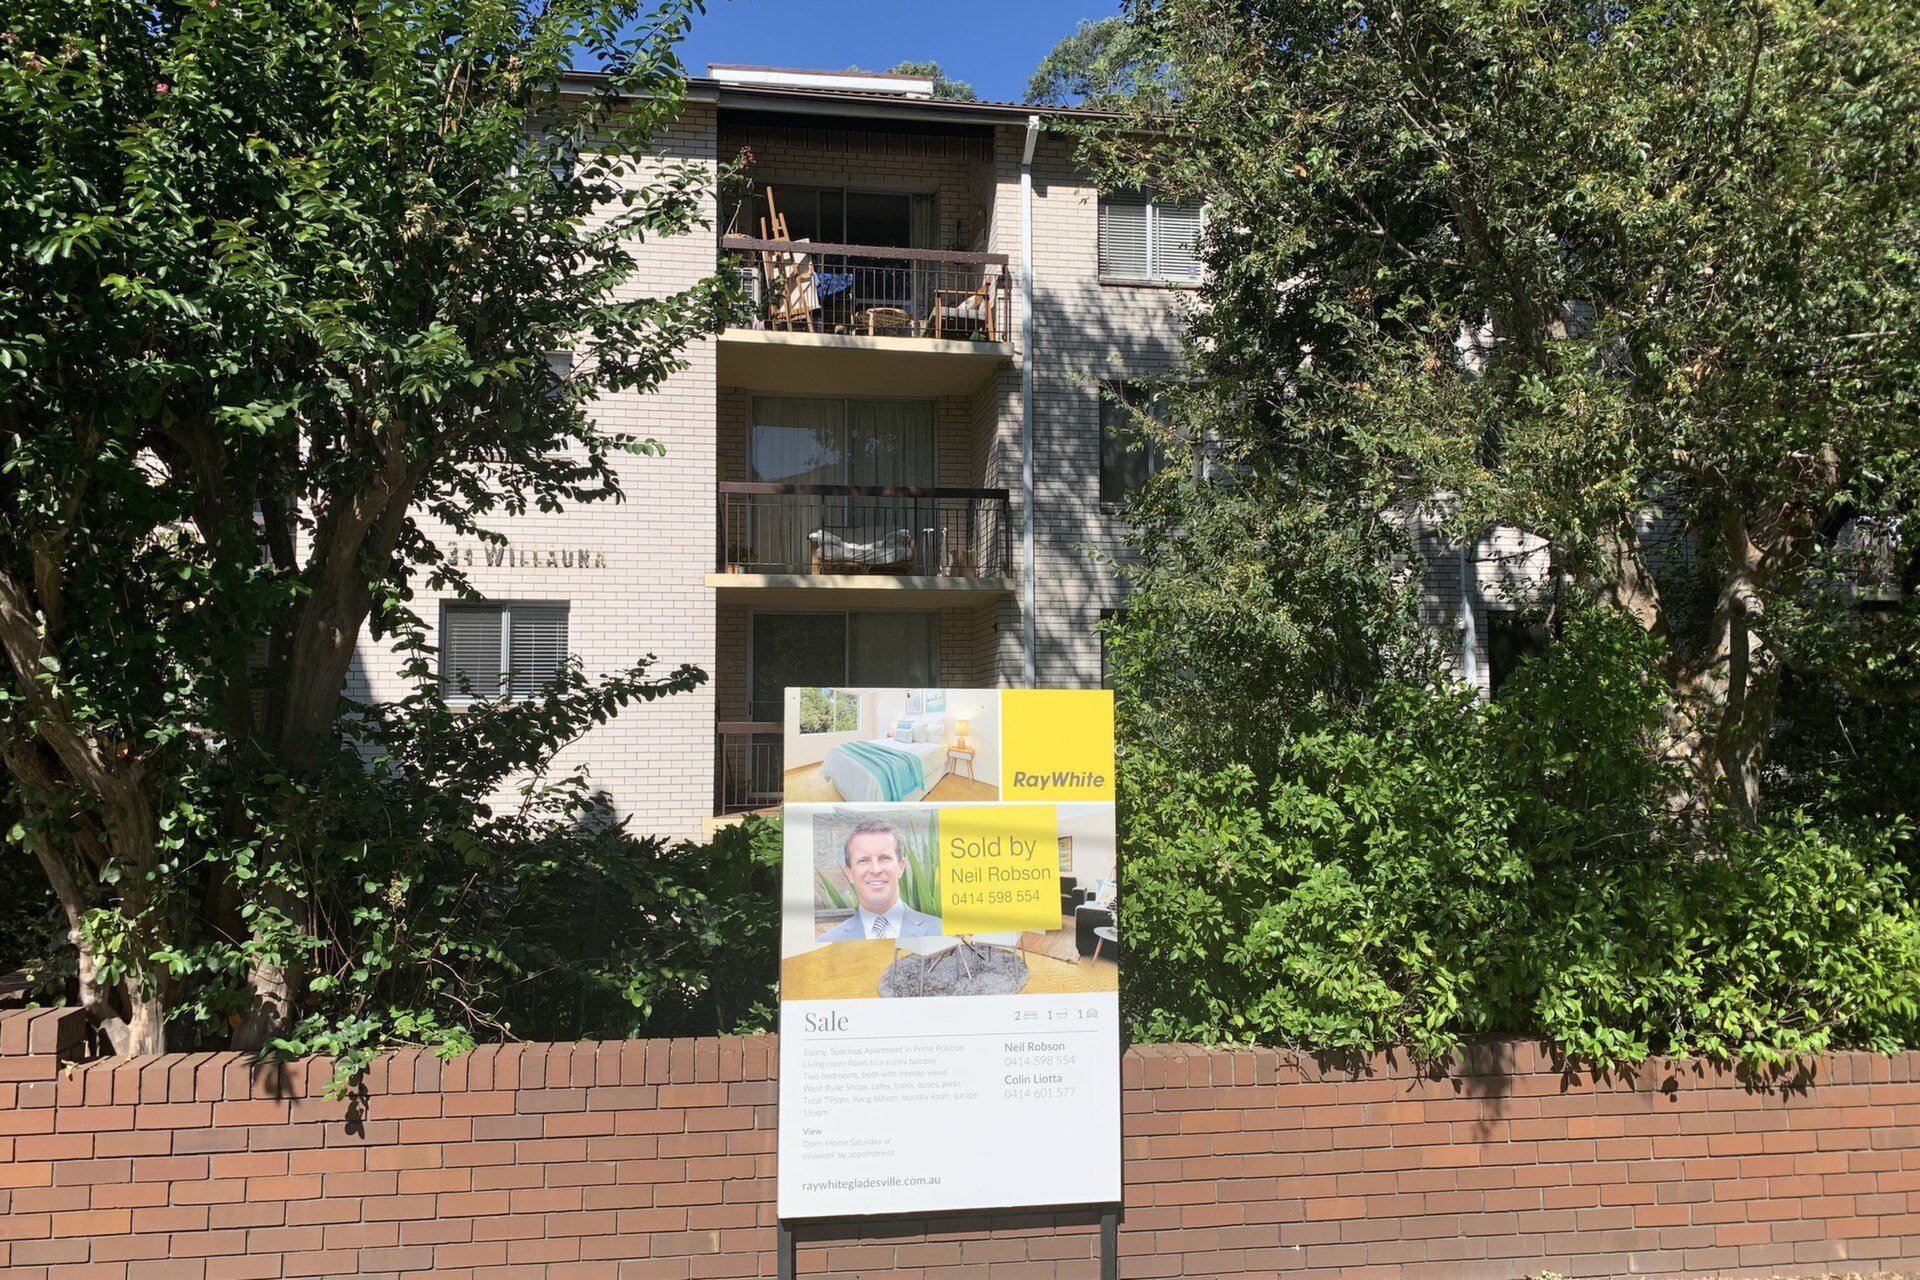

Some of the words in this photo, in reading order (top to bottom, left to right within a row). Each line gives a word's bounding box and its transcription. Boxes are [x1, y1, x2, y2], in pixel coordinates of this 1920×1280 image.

[950, 837, 1001, 860] Sold
[1009, 835, 1037, 861] by
[951, 867, 982, 884] Neil
[988, 866, 1051, 882] Robson
[951, 892, 984, 906] 0414
[988, 891, 1013, 905] 598
[1016, 890, 1040, 903] 554
[1014, 1010, 1021, 1021] 2
[1047, 1010, 1053, 1020] 1
[1077, 1009, 1083, 1019] 1
[804, 1010, 849, 1034] Sale
[802, 1048, 829, 1057] Sunny,
[830, 1047, 863, 1056] Spacious
[864, 1046, 903, 1056] Apartment
[904, 1045, 912, 1053] in
[913, 1045, 935, 1053] Prime
[935, 1044, 965, 1052] Position
[1004, 1042, 1025, 1052] Neil
[1027, 1041, 1065, 1052] Robson
[802, 1061, 825, 1070] Living
[826, 1060, 847, 1068] room
[848, 1059, 869, 1067] flows
[908, 1058, 937, 1066] balcony
[1003, 1056, 1031, 1067] 0414
[1033, 1055, 1054, 1066] 598
[1056, 1054, 1076, 1066] 554
[803, 1072, 820, 1080] Two
[821, 1072, 861, 1080] bedrooms,
[861, 1070, 880, 1079] both
[880, 1070, 898, 1078] with
[898, 1069, 926, 1078] treetop
[927, 1069, 948, 1077] views
[1004, 1074, 1031, 1085] Colin
[1033, 1073, 1063, 1084] Liotta
[803, 1085, 824, 1093] West
[824, 1084, 844, 1092] Ryde
[845, 1083, 870, 1092] Shops,
[870, 1082, 893, 1090] cafes,
[941, 1080, 962, 1089] parks
[1003, 1088, 1031, 1100] 0414
[1033, 1088, 1053, 1099] 601
[1056, 1086, 1076, 1098] 577
[803, 1096, 822, 1105] Total
[852, 1095, 872, 1104] living
[901, 1093, 929, 1102] laundry
[953, 1092, 978, 1101] garage
[803, 1108, 829, 1119] 15sqm
[802, 1127, 823, 1136] View
[801, 1139, 824, 1149] Open
[825, 1139, 849, 1147] Home
[849, 1137, 883, 1147] Saturday
[801, 1150, 836, 1160] midweek
[837, 1150, 847, 1160] by
[848, 1149, 896, 1159] appointment
[801, 1176, 941, 1192] raywhitegladesville.com.au
